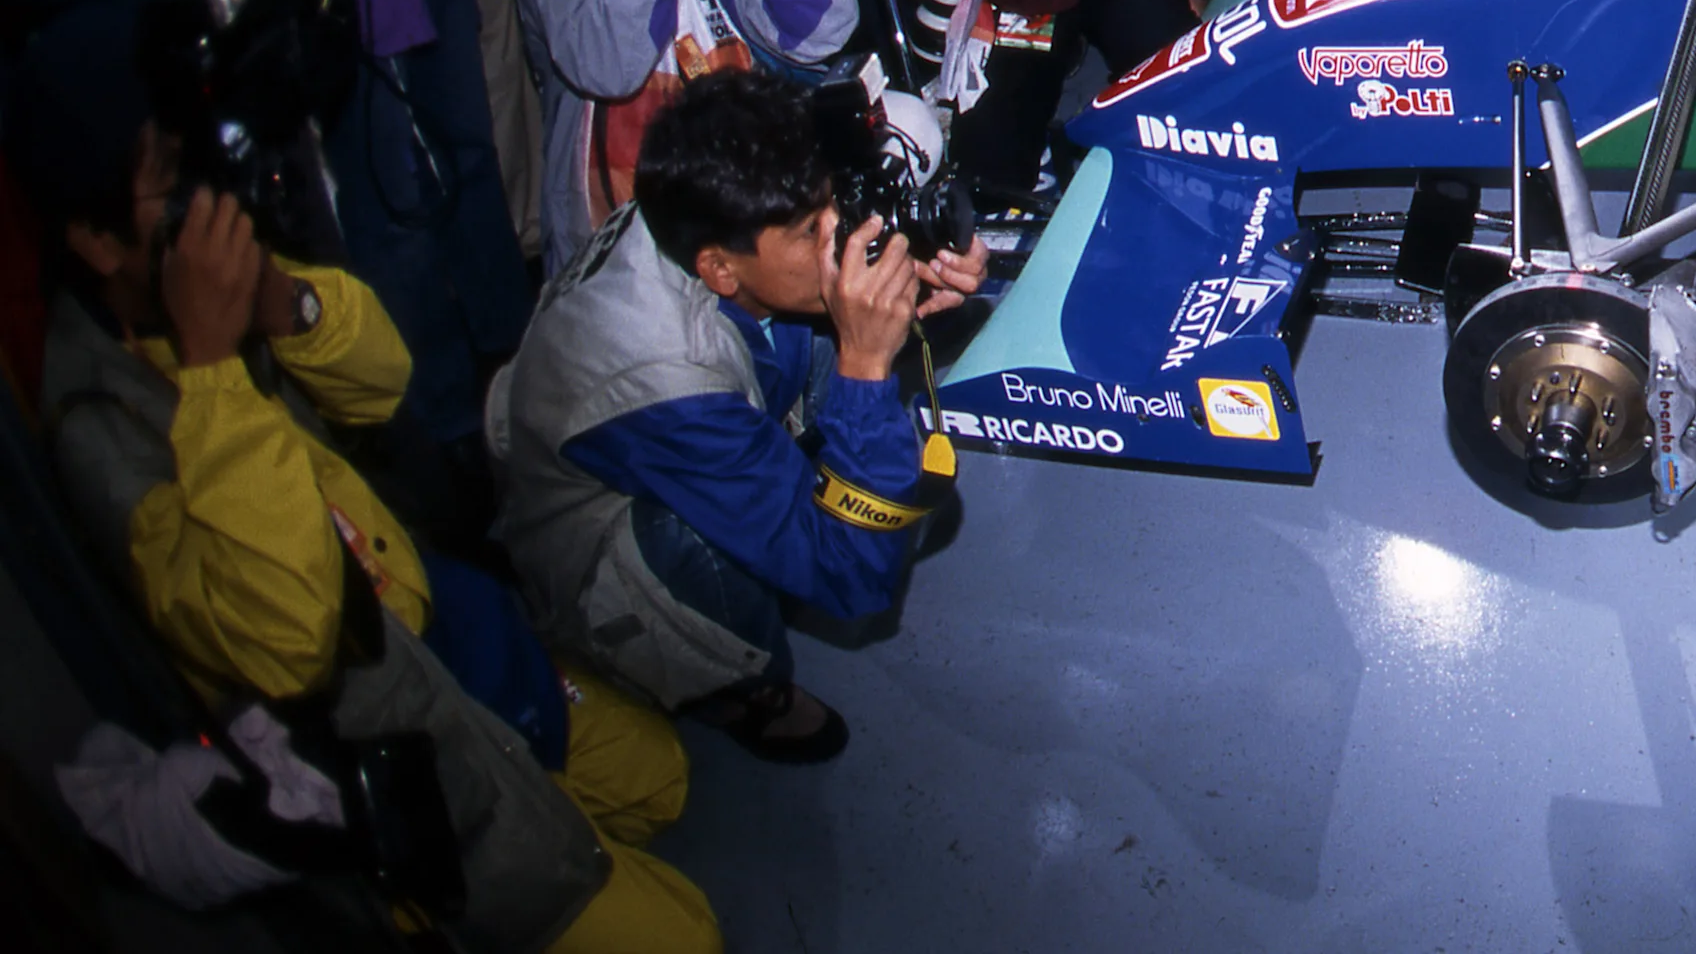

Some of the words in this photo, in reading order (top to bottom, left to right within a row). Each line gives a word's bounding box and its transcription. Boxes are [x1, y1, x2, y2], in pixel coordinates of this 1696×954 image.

[1298, 39, 1448, 85] Vaporetto
[1136, 113, 1279, 162] Diavia
[1001, 372, 1093, 410] Bruno
[1100, 382, 1185, 419] Minelli
[984, 415, 1125, 454] RICARDO
[1659, 390, 1676, 453] brembo
[838, 493, 903, 526] Nikon
